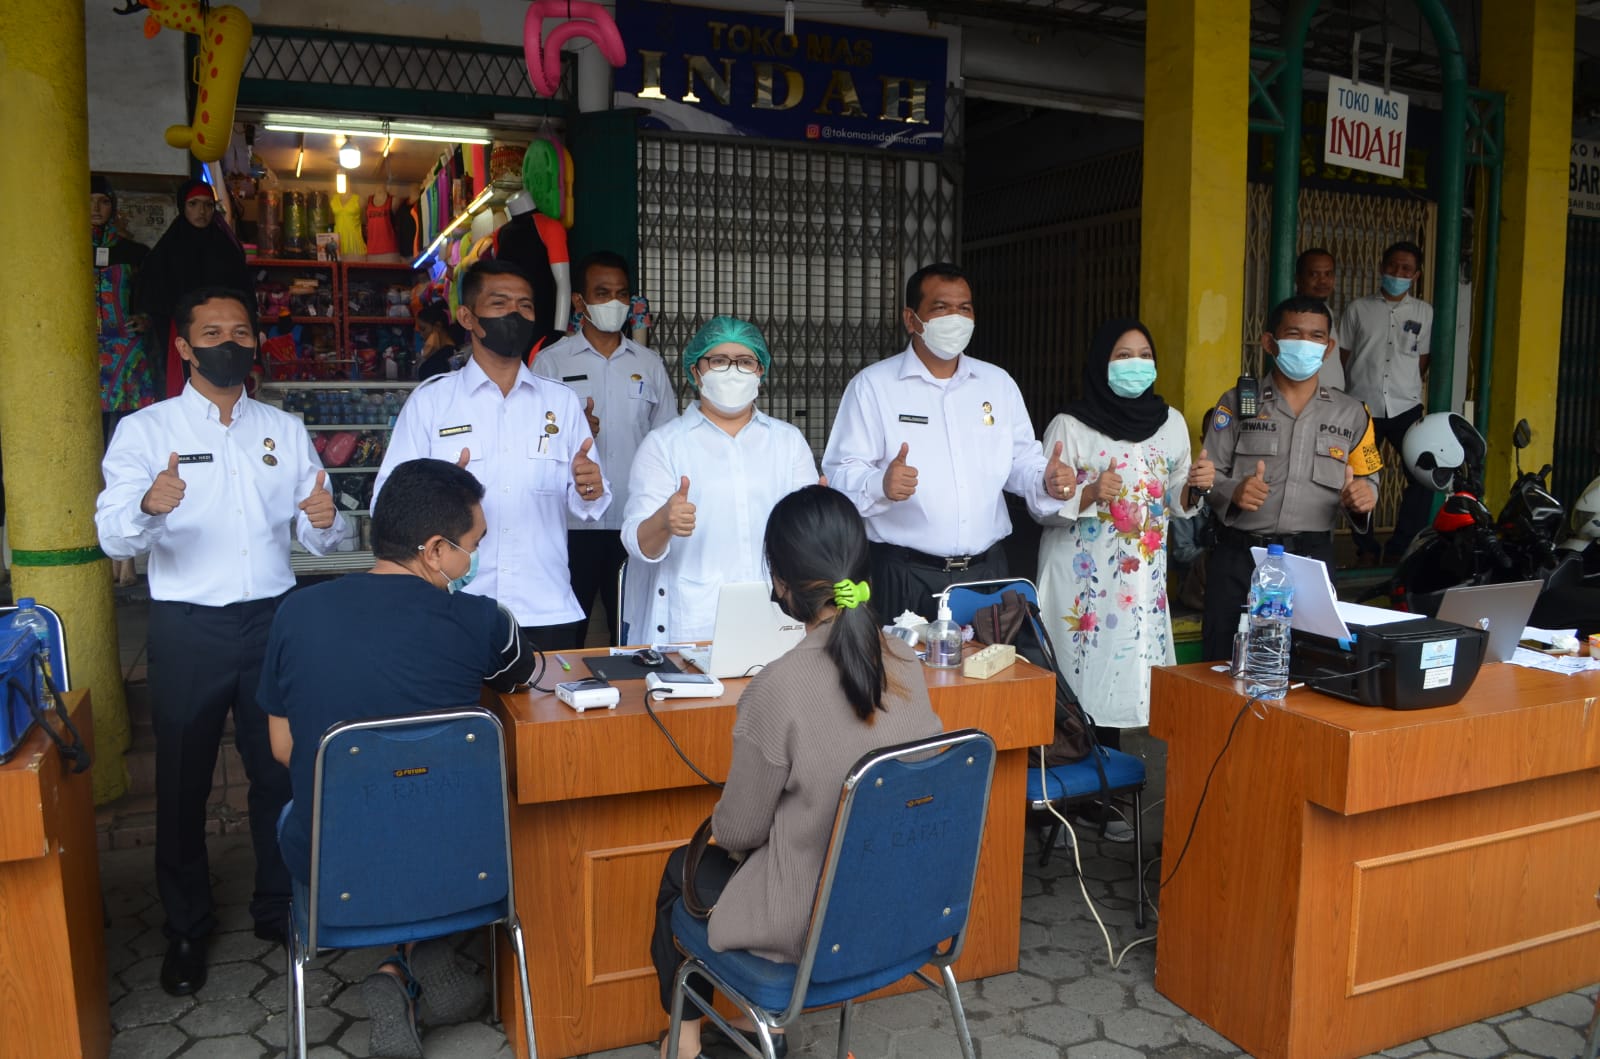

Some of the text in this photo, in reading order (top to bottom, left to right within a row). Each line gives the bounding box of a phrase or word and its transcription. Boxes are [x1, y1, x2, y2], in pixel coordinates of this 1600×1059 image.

[706, 21, 873, 66] TOKO MAS
[637, 49, 931, 125] INDAH
[1338, 88, 1399, 120] TOKO MAS
[1329, 115, 1403, 168] INDAH
[1319, 423, 1353, 440] POLRI
